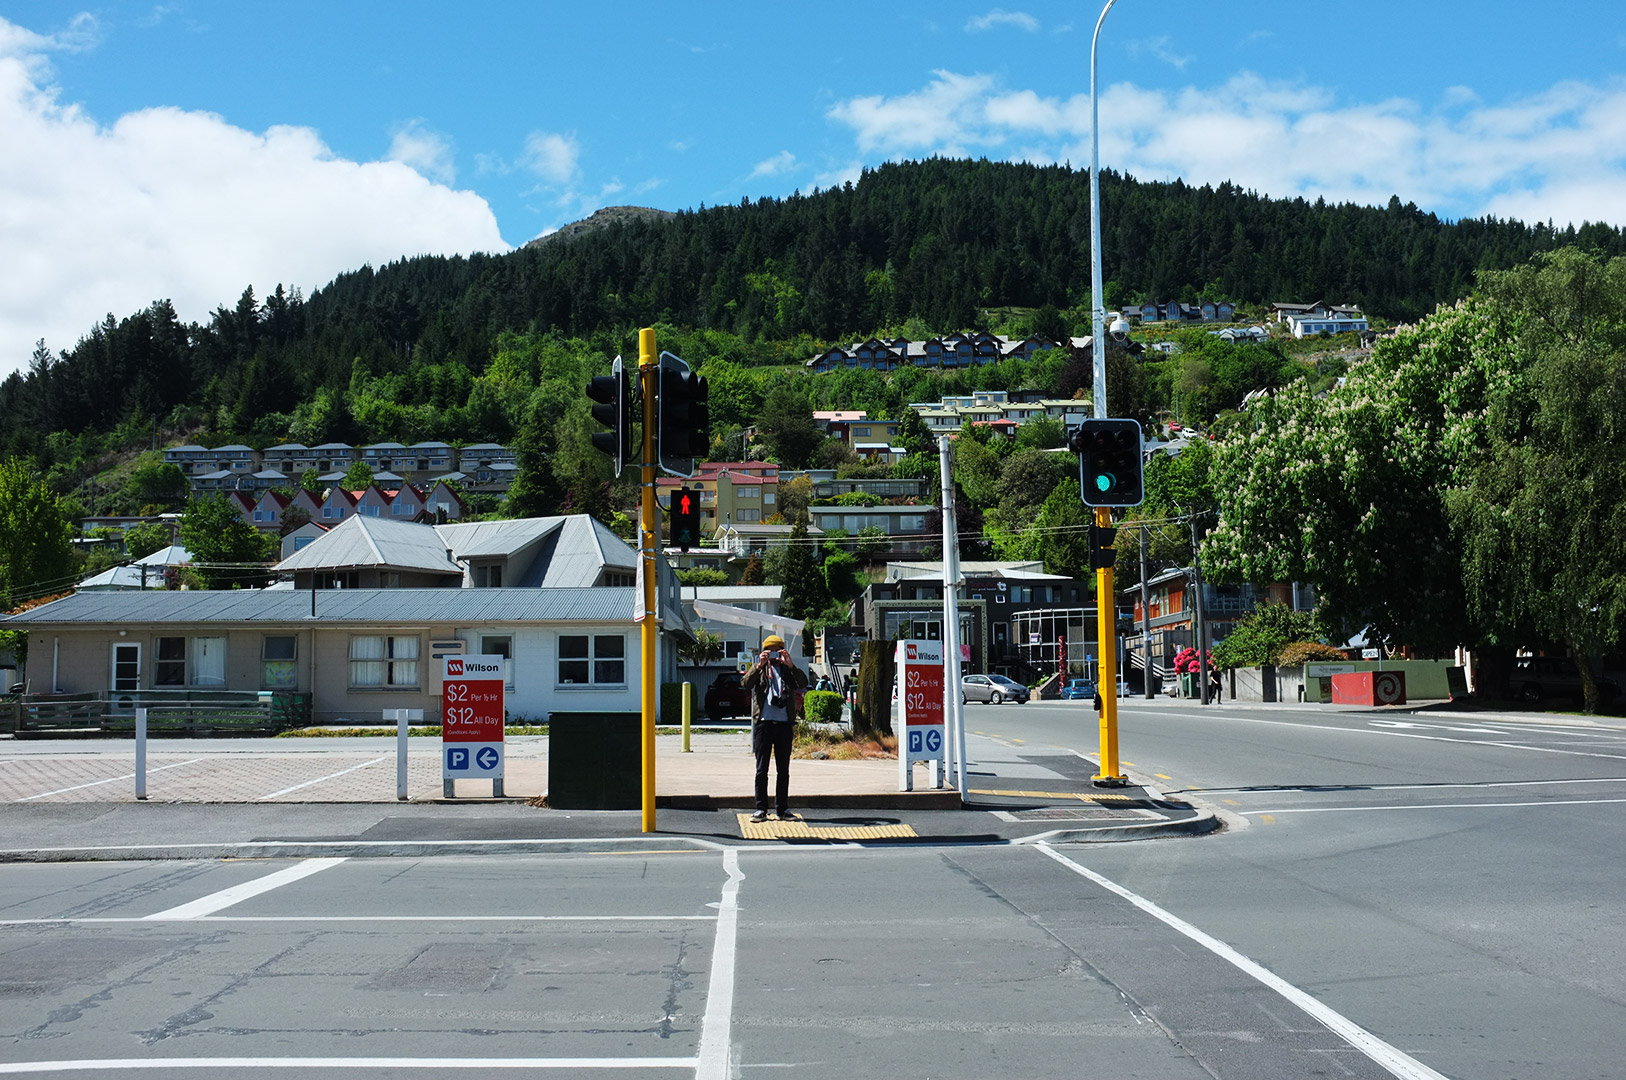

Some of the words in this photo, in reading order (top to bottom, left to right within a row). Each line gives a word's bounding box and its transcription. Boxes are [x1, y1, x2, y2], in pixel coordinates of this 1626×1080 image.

[918, 652, 939, 661] Wilson
[465, 663, 499, 672] Wilson
[907, 671, 920, 689] $2
[447, 683, 468, 703] $2
[470, 694, 482, 702] Per
[490, 694, 498, 702] Hr
[907, 692, 924, 711] $12
[932, 702, 941, 711] Day
[447, 706, 474, 726] $12
[474, 716, 483, 724] All
[485, 716, 499, 726] Day
[912, 735, 920, 749] P
[452, 752, 465, 767] P
